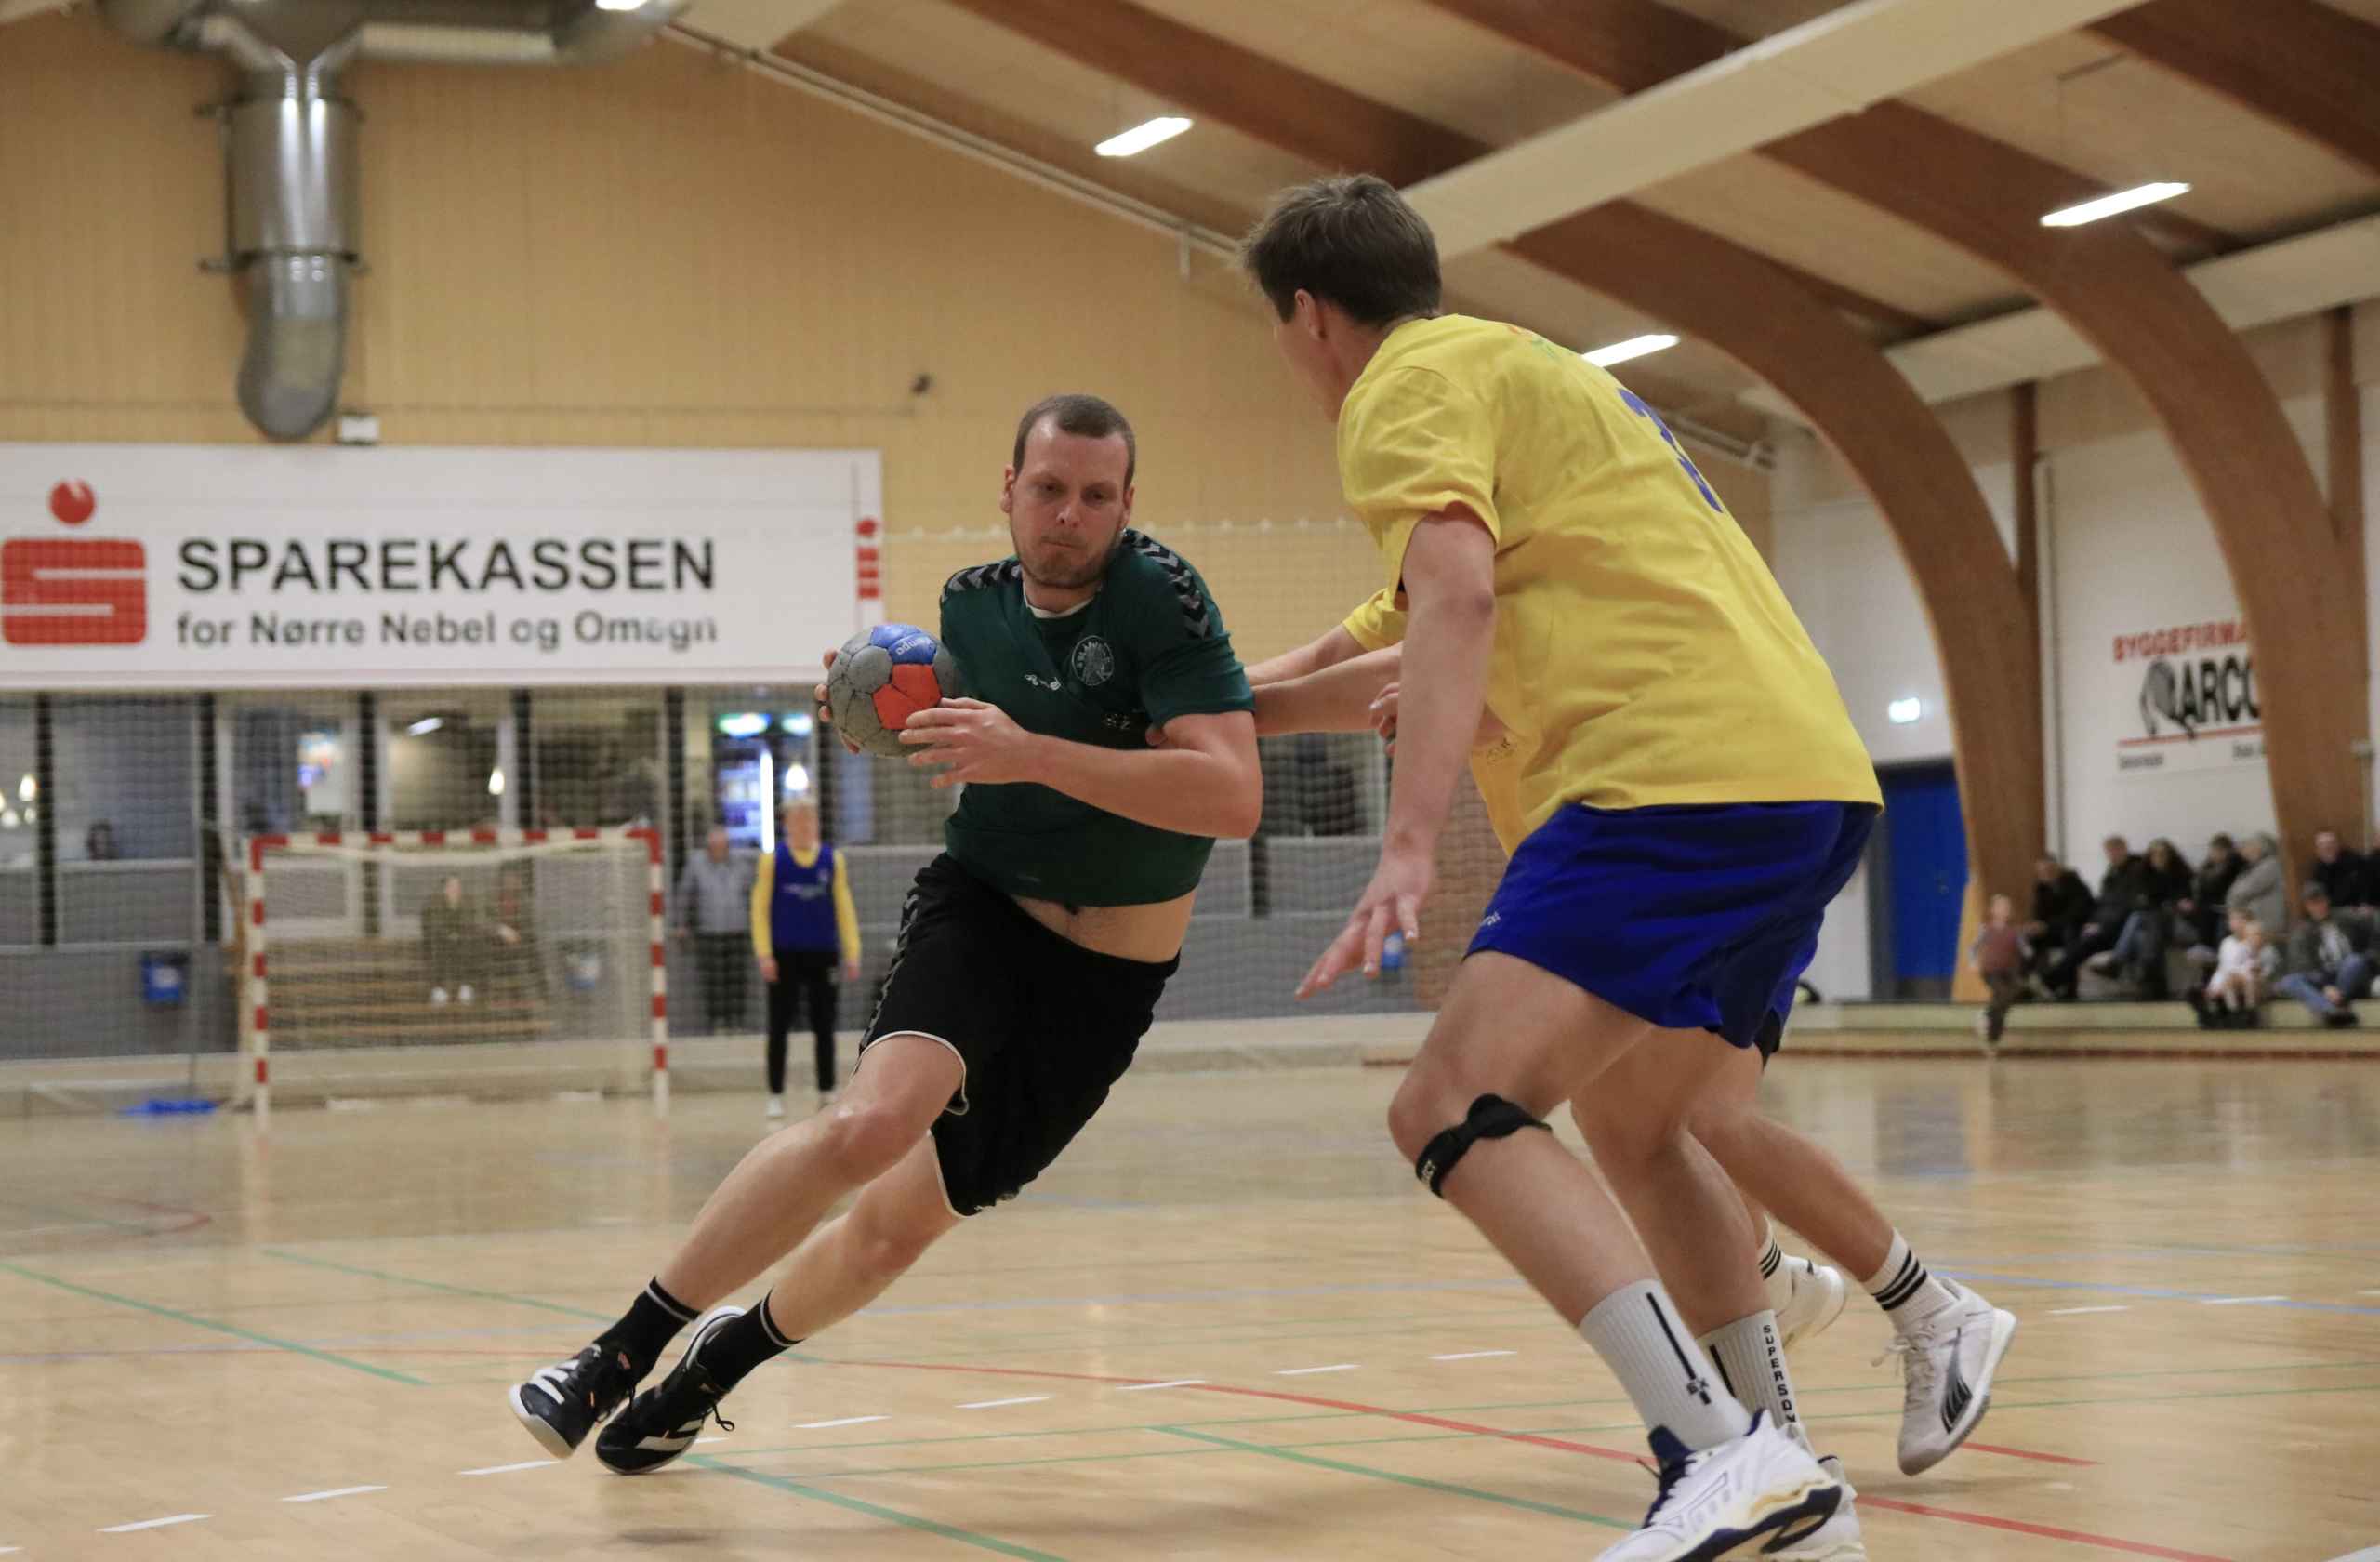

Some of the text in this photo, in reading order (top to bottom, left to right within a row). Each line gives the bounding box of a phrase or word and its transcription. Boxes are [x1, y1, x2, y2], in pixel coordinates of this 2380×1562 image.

[178, 538, 714, 592] SPAREKASSEN
[178, 611, 234, 644] for
[250, 611, 366, 644] Nørre
[381, 611, 496, 644] Nebel
[510, 618, 560, 652] og
